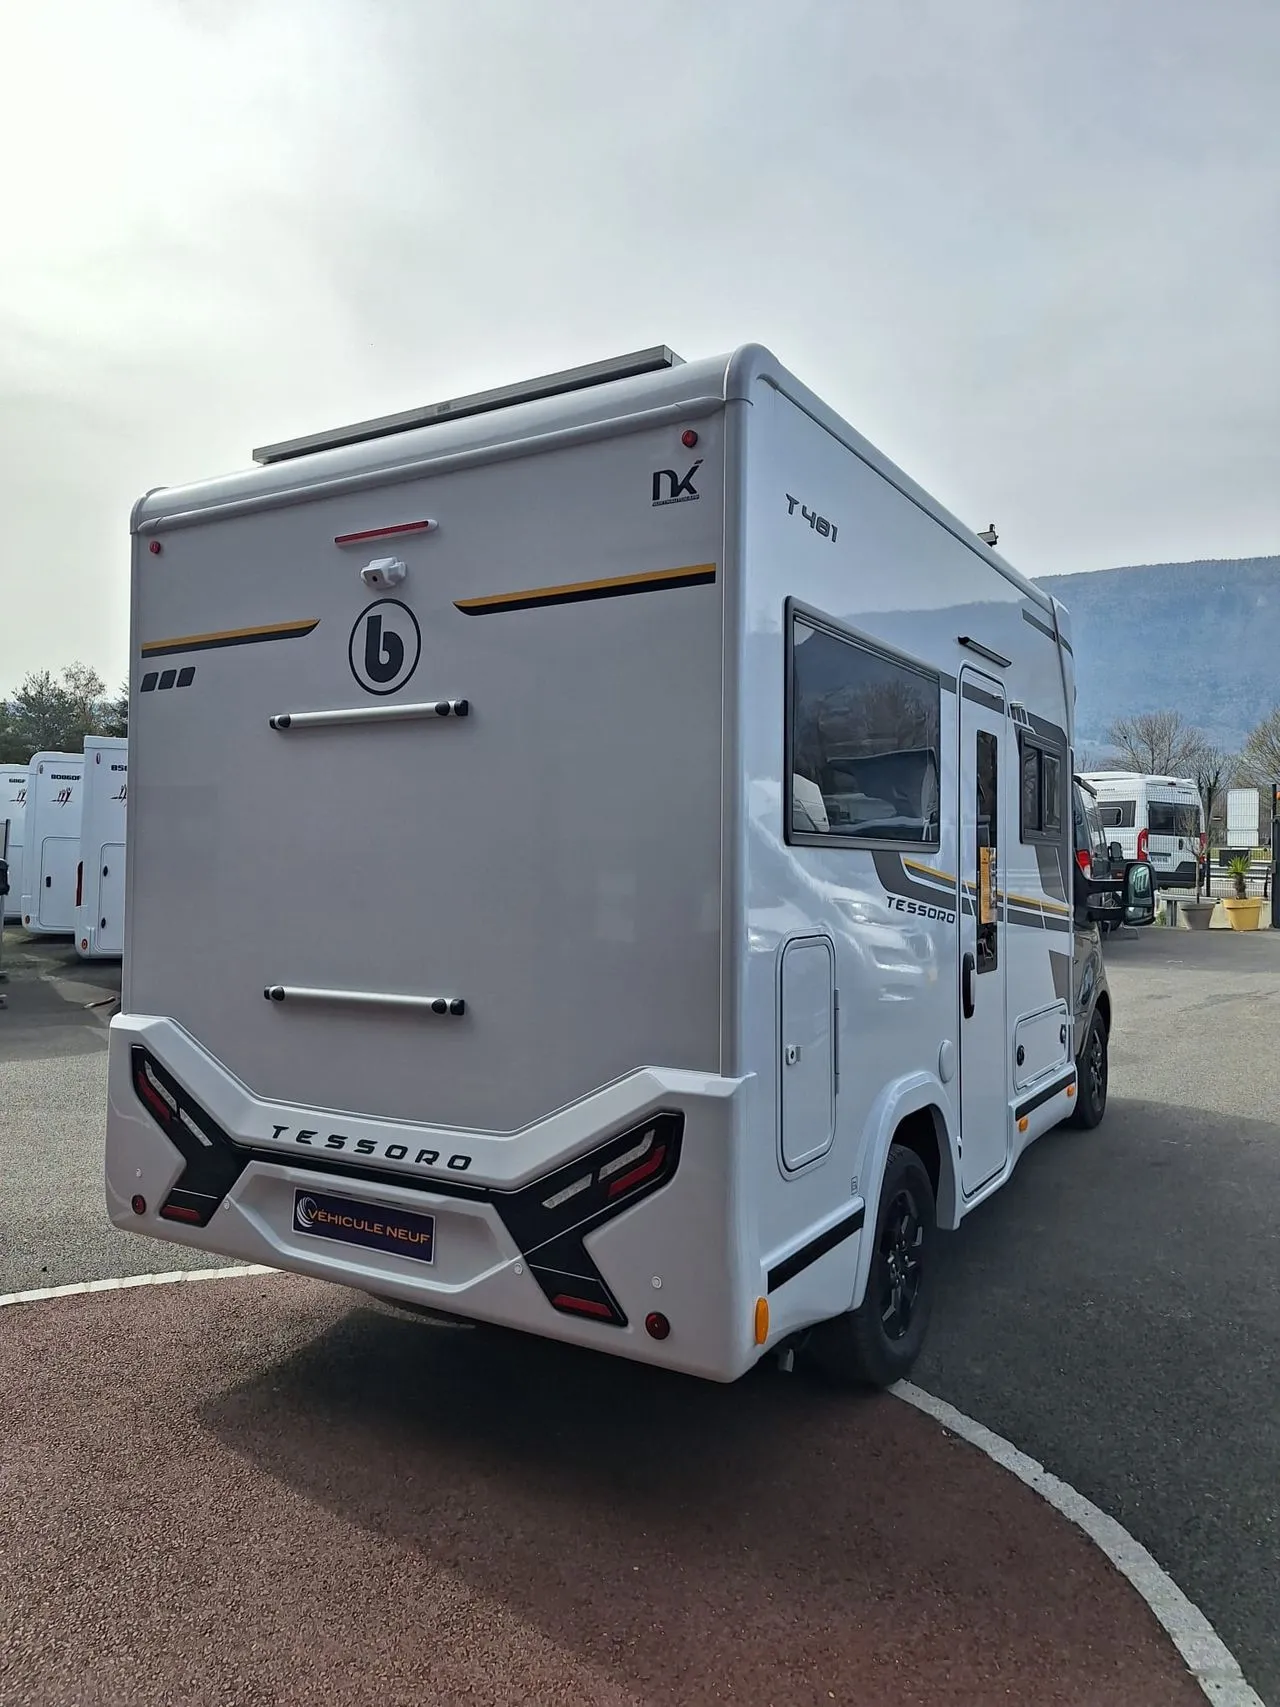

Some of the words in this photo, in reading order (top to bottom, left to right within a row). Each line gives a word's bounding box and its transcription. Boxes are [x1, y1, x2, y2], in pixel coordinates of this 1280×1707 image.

[785, 493, 800, 516] T
[801, 504, 839, 543] 481
[886, 895, 956, 925] TESSORO
[272, 1124, 473, 1171] TESSORO
[307, 1208, 384, 1235] VÉHICULE
[385, 1226, 431, 1245] NEUF
